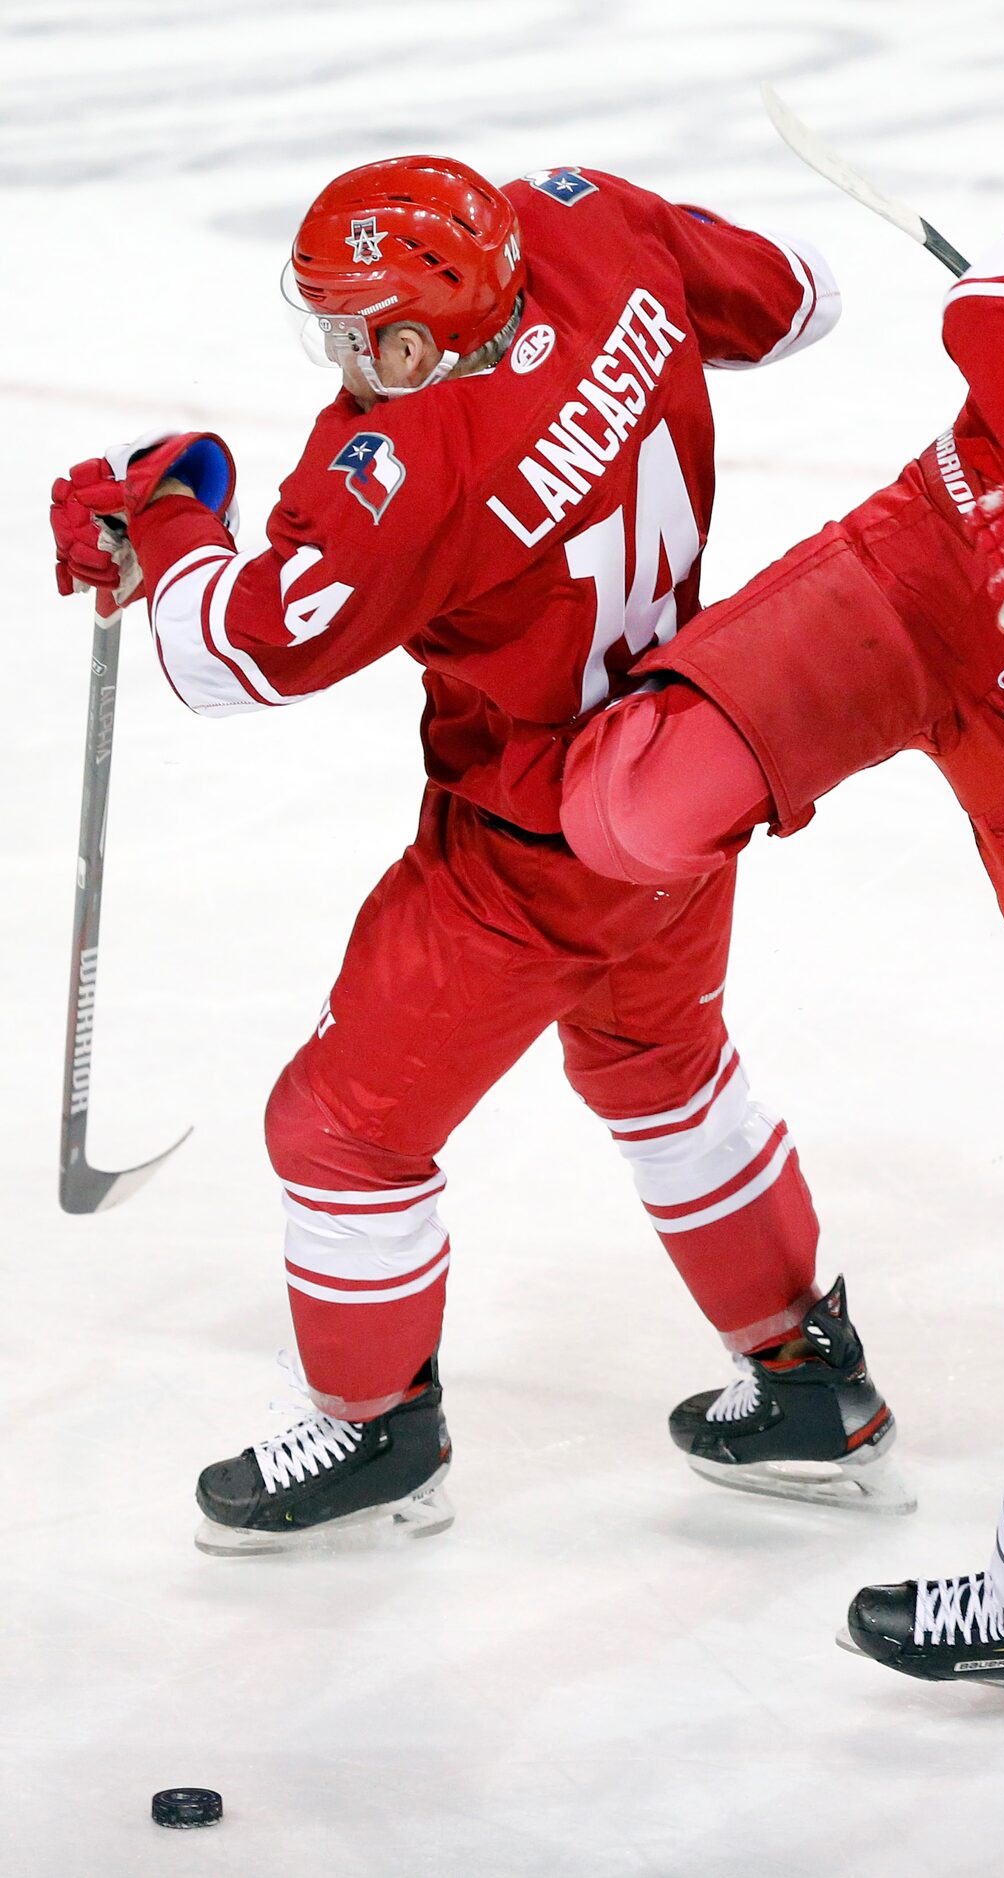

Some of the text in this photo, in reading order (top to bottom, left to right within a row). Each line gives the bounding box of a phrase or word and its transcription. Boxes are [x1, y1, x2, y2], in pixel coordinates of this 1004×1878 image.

[504, 233, 521, 272] 14
[486, 287, 687, 549] LANCASTER
[279, 543, 355, 648] 14
[563, 416, 702, 718] 14
[70, 946, 99, 1116] WARRIOR
